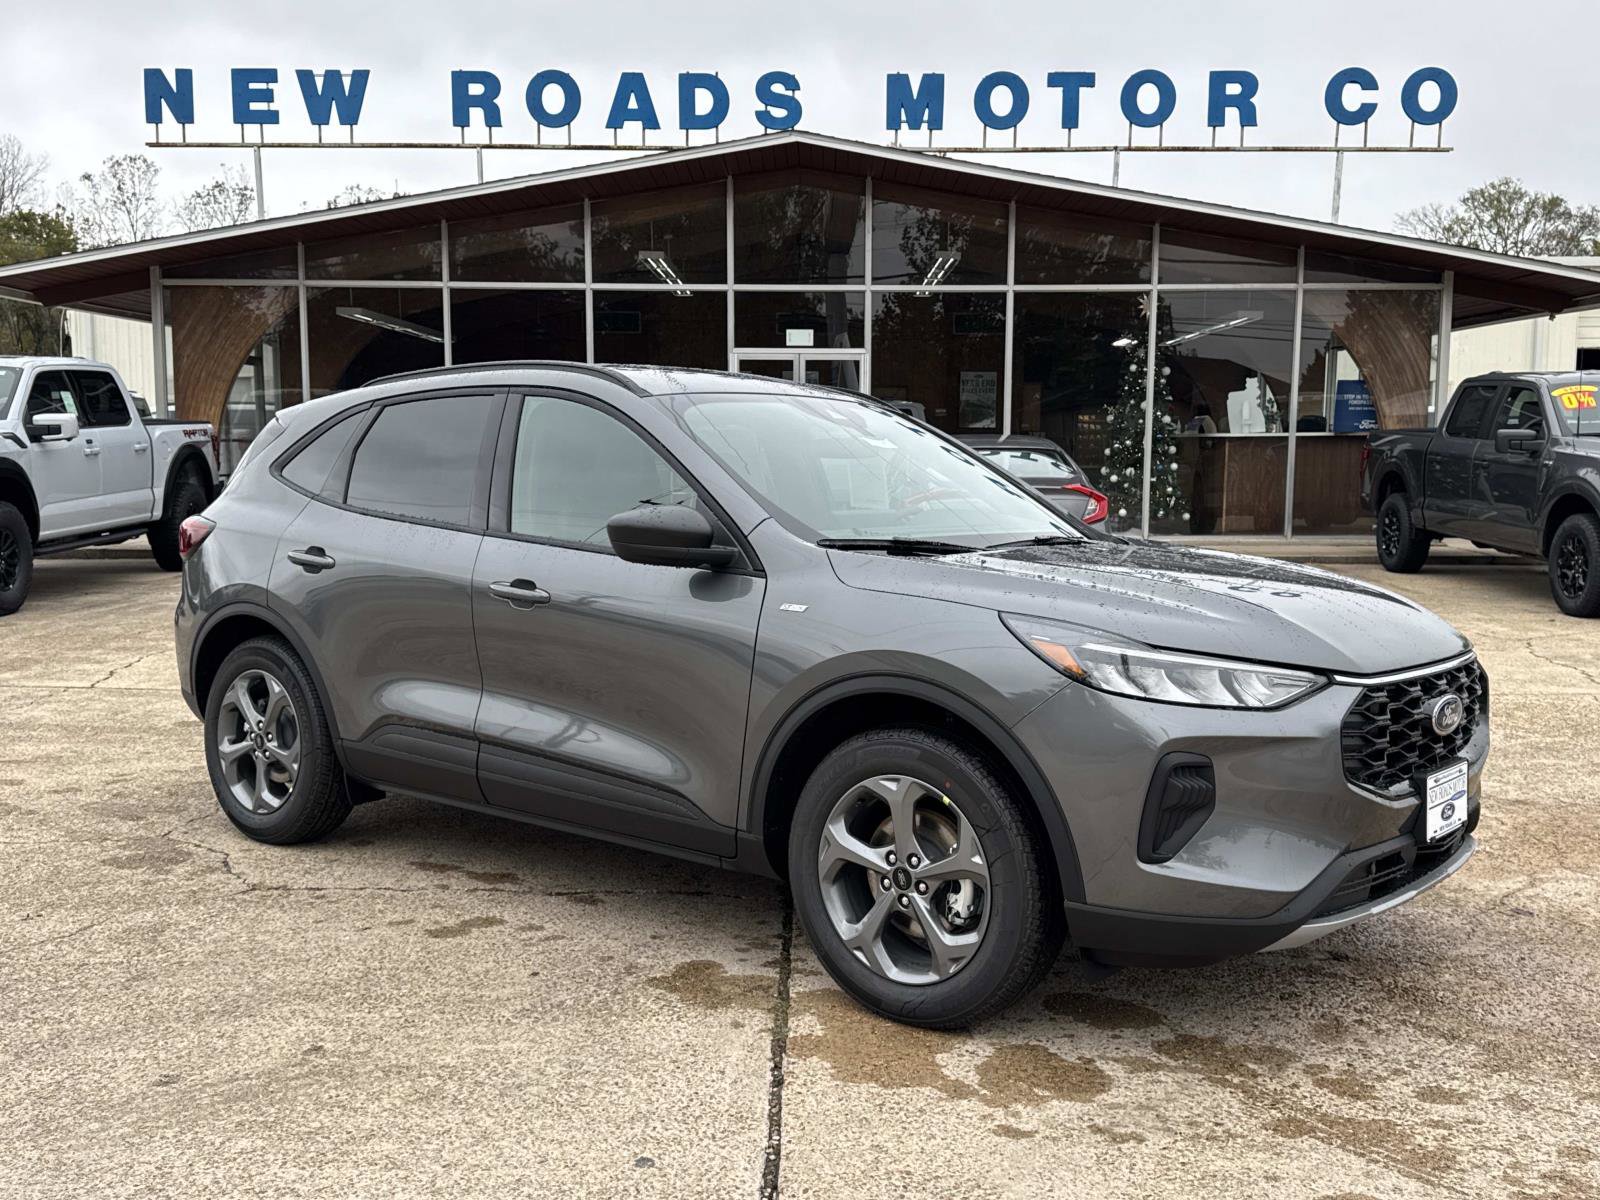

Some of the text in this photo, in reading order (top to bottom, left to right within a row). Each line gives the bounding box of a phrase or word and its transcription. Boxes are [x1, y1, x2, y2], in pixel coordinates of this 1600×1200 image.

[144, 67, 1457, 131] NEW ROADS MOTOR CO
[1560, 391, 1597, 409] 0%
[182, 428, 210, 439] RAPTOR
